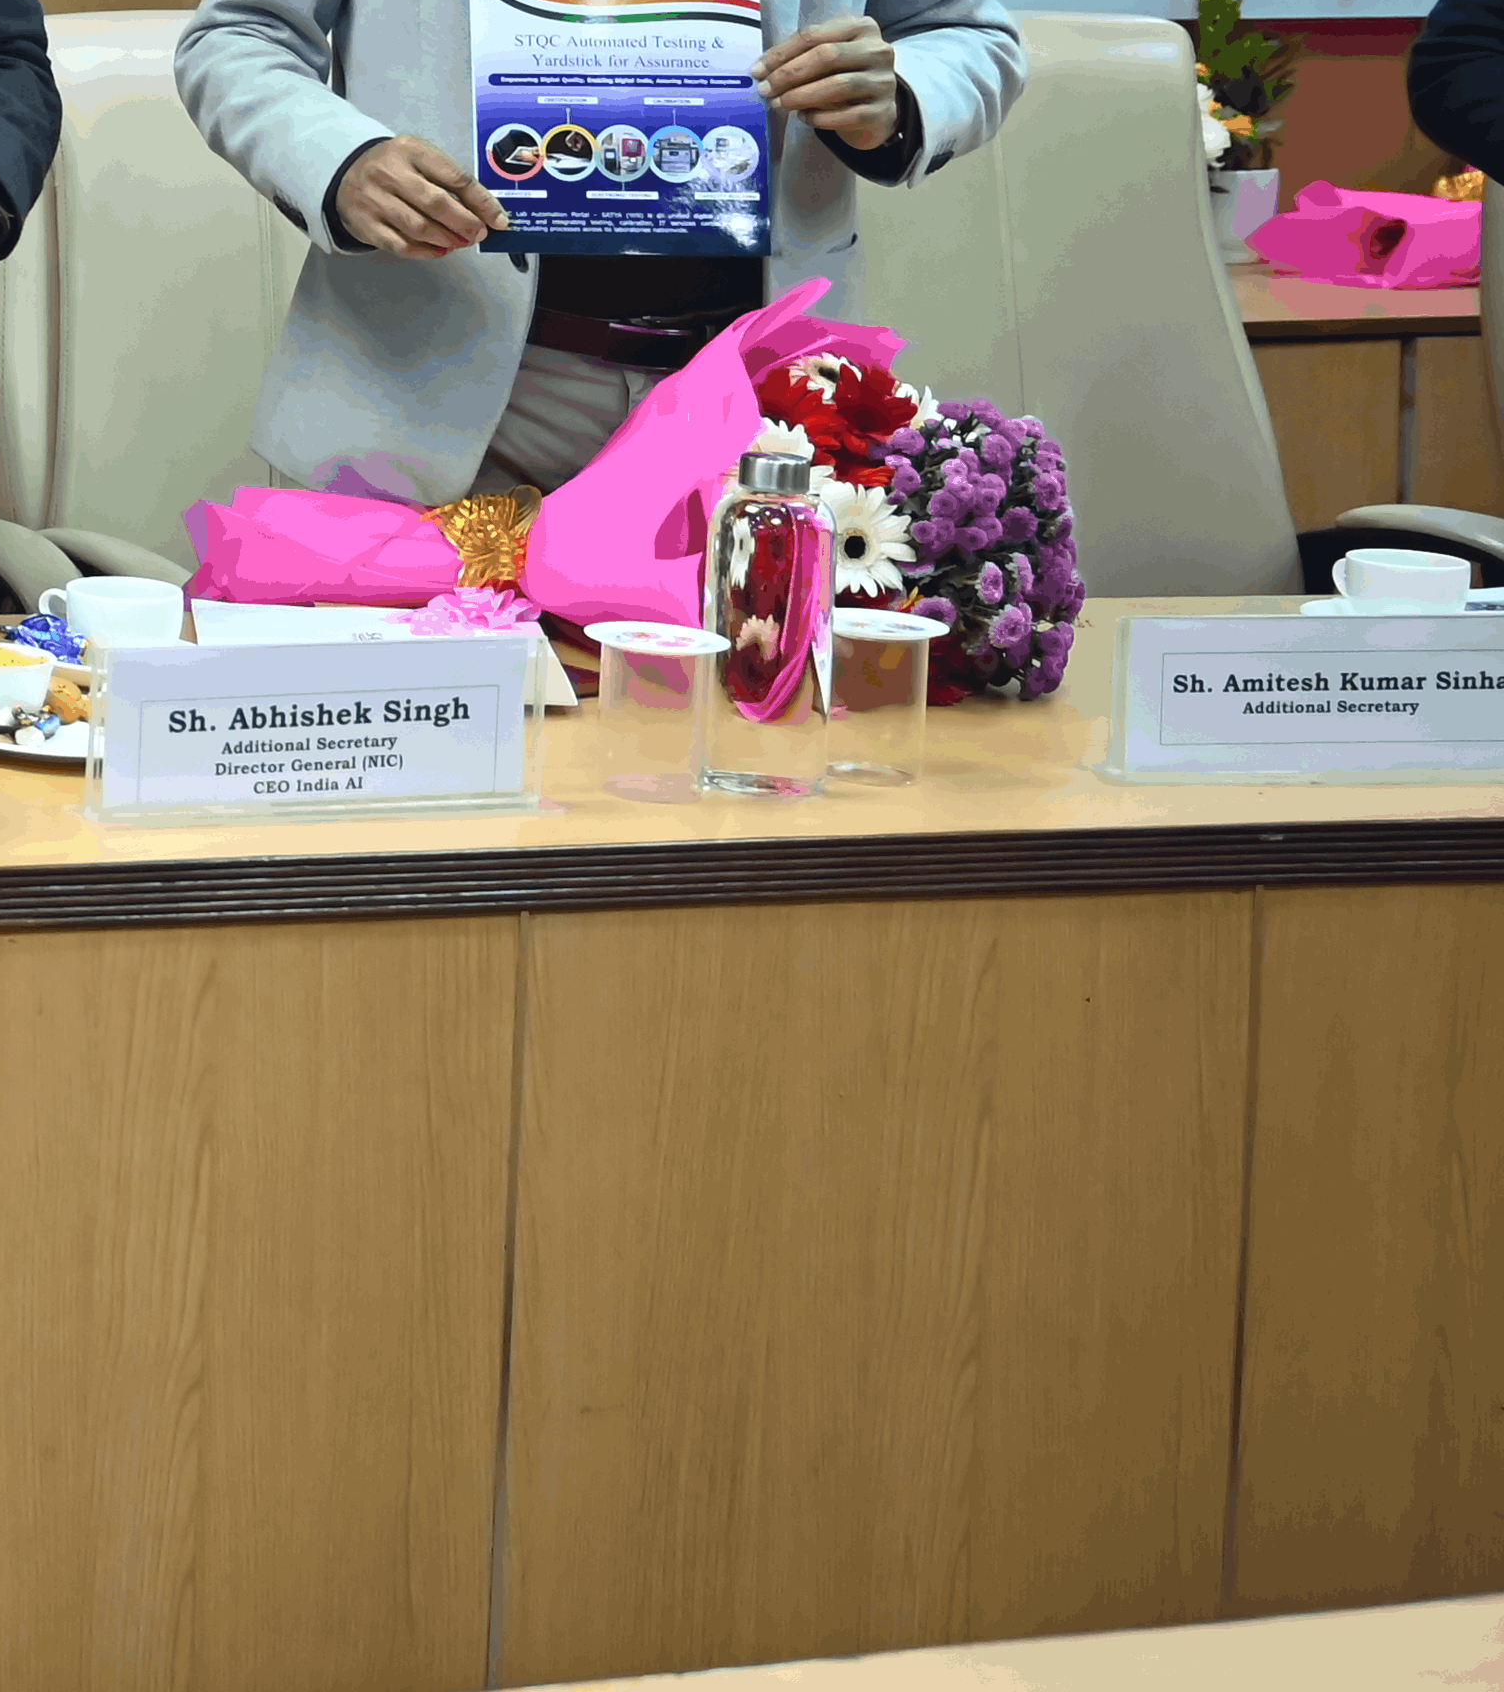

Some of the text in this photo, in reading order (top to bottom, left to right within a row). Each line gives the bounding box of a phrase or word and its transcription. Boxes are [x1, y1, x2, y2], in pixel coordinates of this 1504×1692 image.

[514, 35, 724, 51] STQC Automated Testing &
[532, 53, 710, 68] Yardstick for Assurance
[1173, 671, 1504, 694] Sh. Amitesh Kumar Sinha
[168, 697, 470, 732] Sh. Abhishek Singh
[1243, 700, 1419, 715] Additional Secretary
[222, 735, 398, 755] Additional Secretary
[215, 754, 404, 776] Director General (NIC)
[253, 777, 363, 794] CEO India AI
